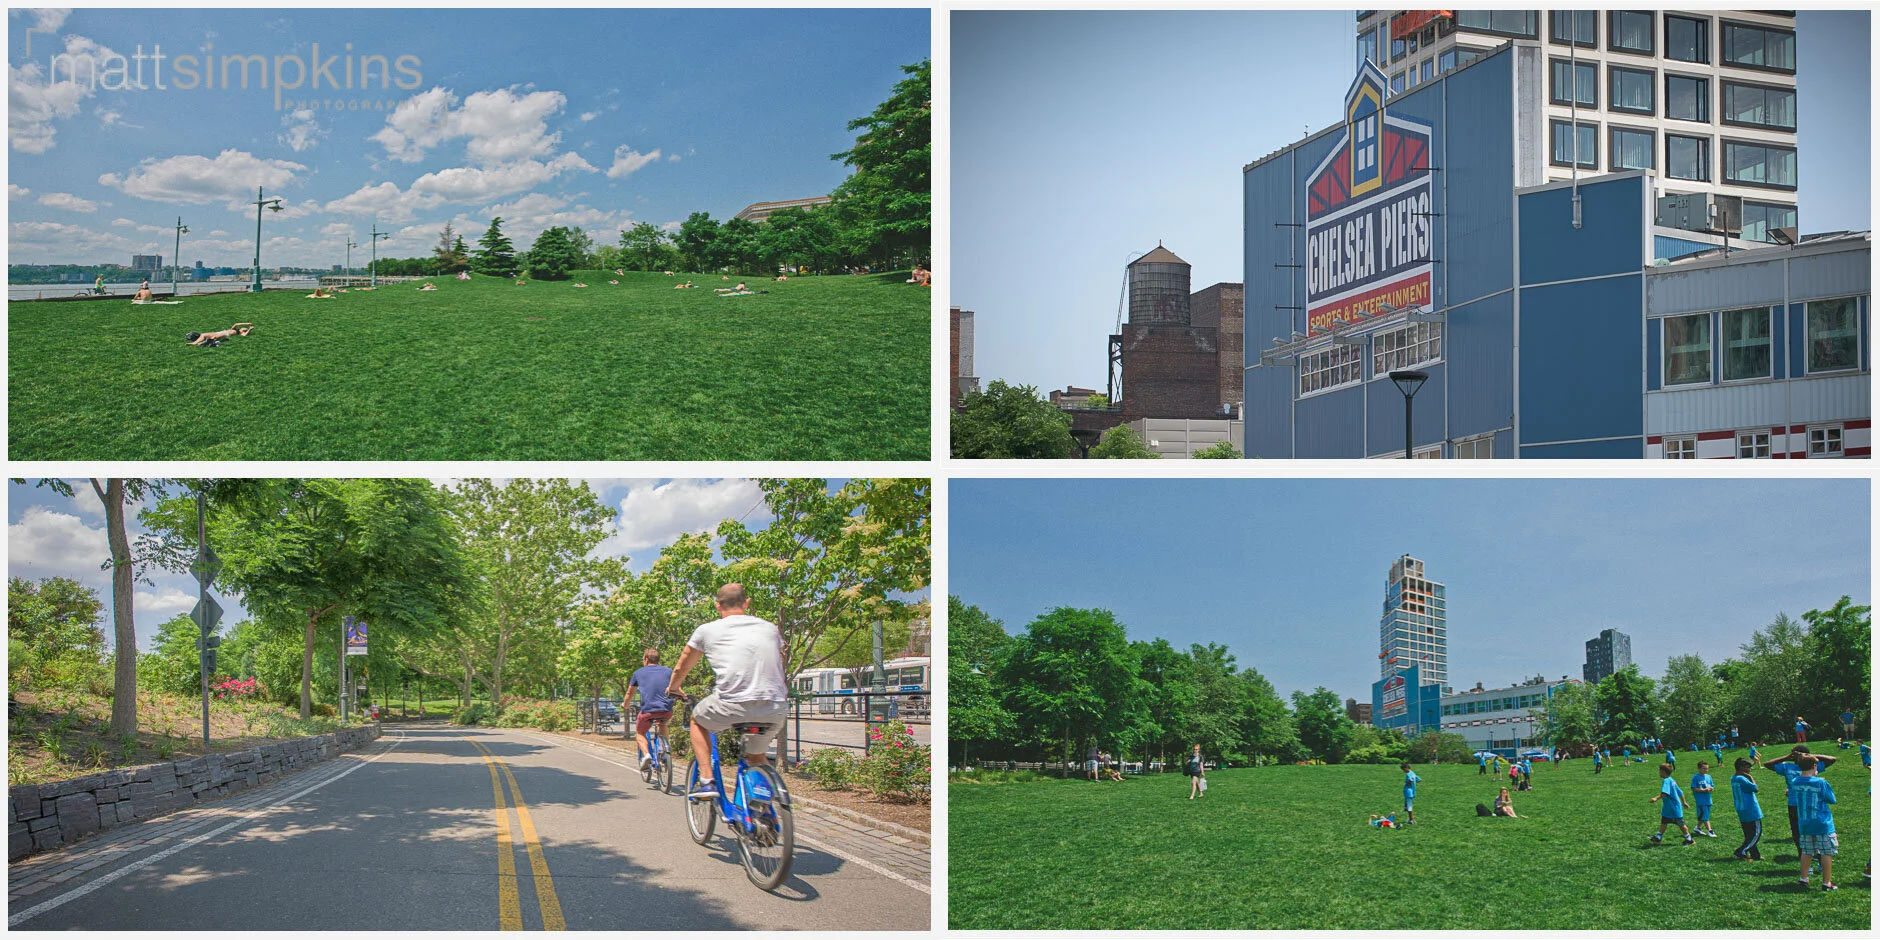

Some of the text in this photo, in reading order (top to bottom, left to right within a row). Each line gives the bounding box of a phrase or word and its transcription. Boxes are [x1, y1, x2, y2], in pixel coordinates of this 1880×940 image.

[1309, 191, 1430, 295] CHELSEA PIERS
[1310, 281, 1429, 332] SPORTS & ENTERTAINMENT
